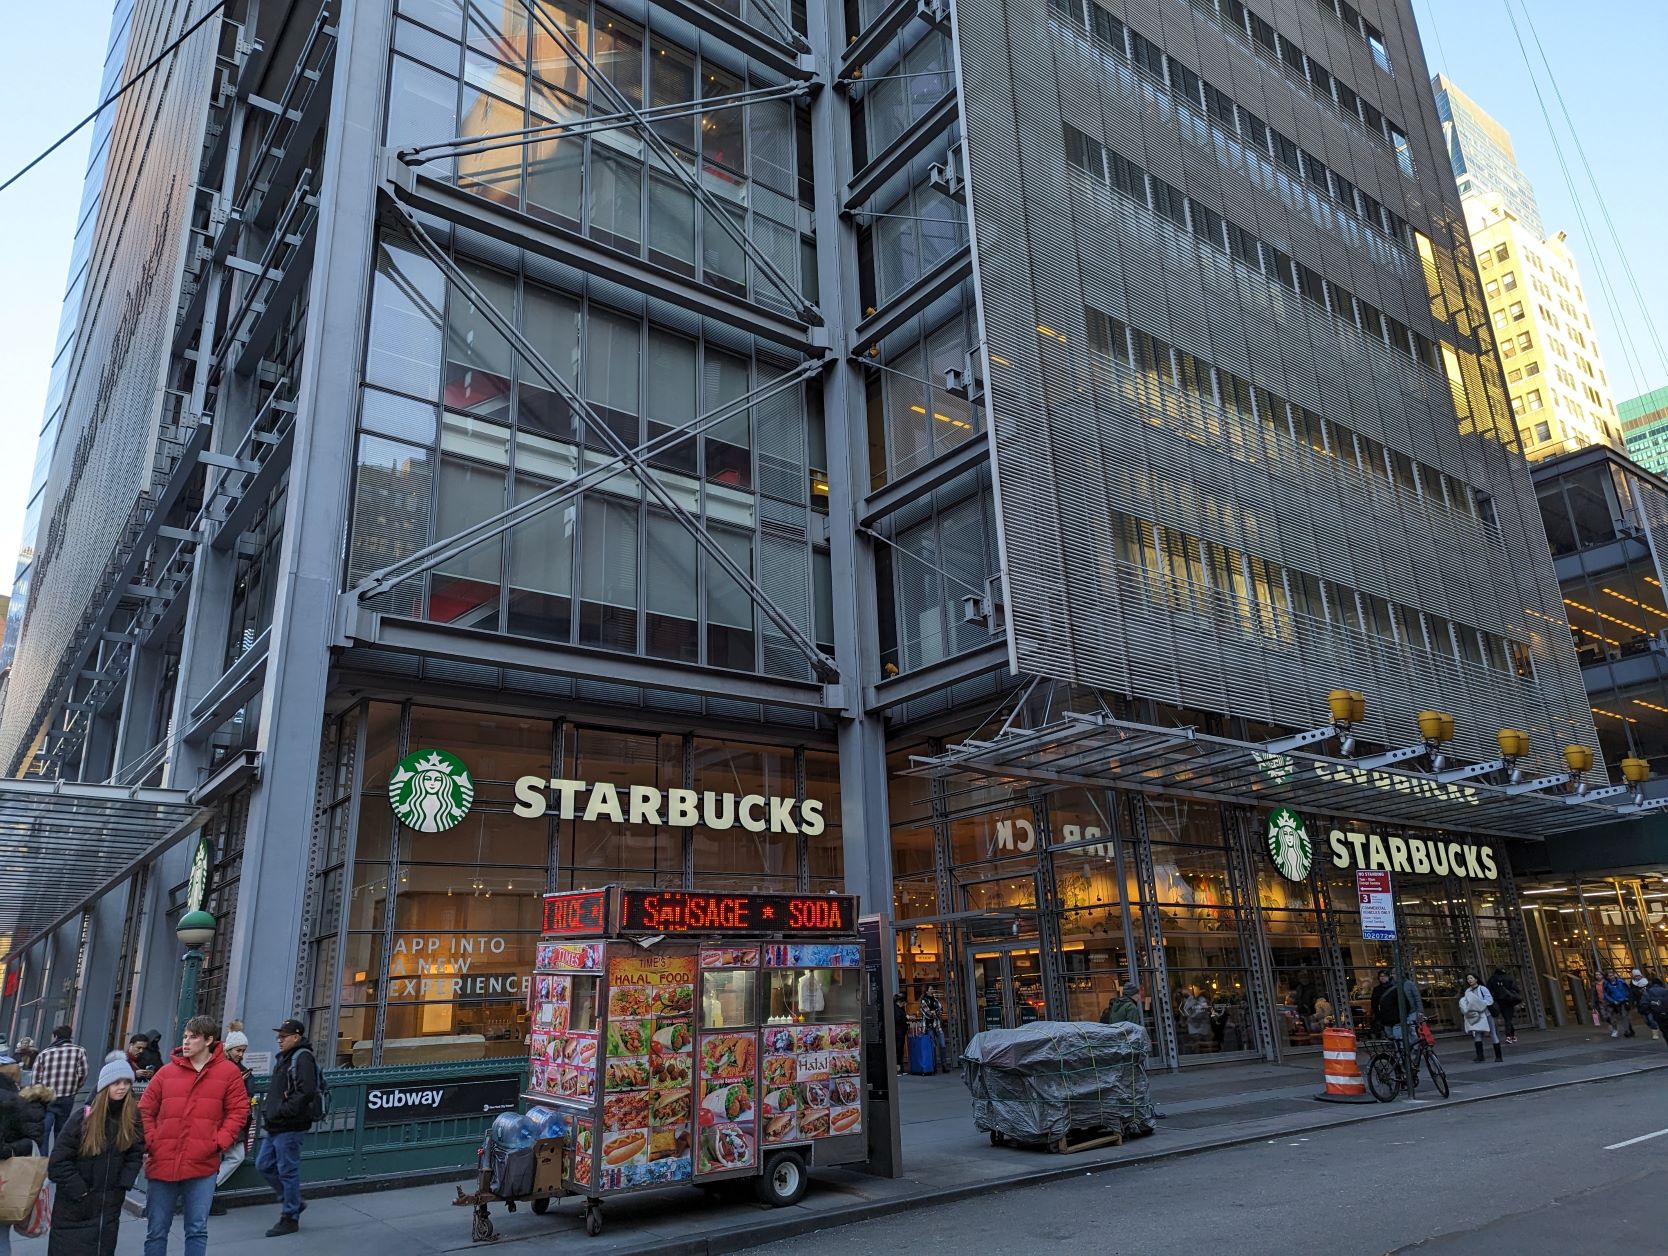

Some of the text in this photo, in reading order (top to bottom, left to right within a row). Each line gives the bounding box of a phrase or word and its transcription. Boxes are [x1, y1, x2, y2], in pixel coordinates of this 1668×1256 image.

[512, 775, 825, 836] STARBUCKS
[1329, 829, 1498, 880] STARBUCKS
[1362, 894, 1369, 903] 3
[789, 900, 842, 928] SODA
[393, 937, 505, 955] APP INTO
[393, 957, 472, 975] A NEW
[389, 976, 531, 997] EXPERIENCE
[615, 972, 689, 985] HALAL FOOD
[798, 1056, 828, 1072] Halal
[367, 1089, 444, 1109] Subway
